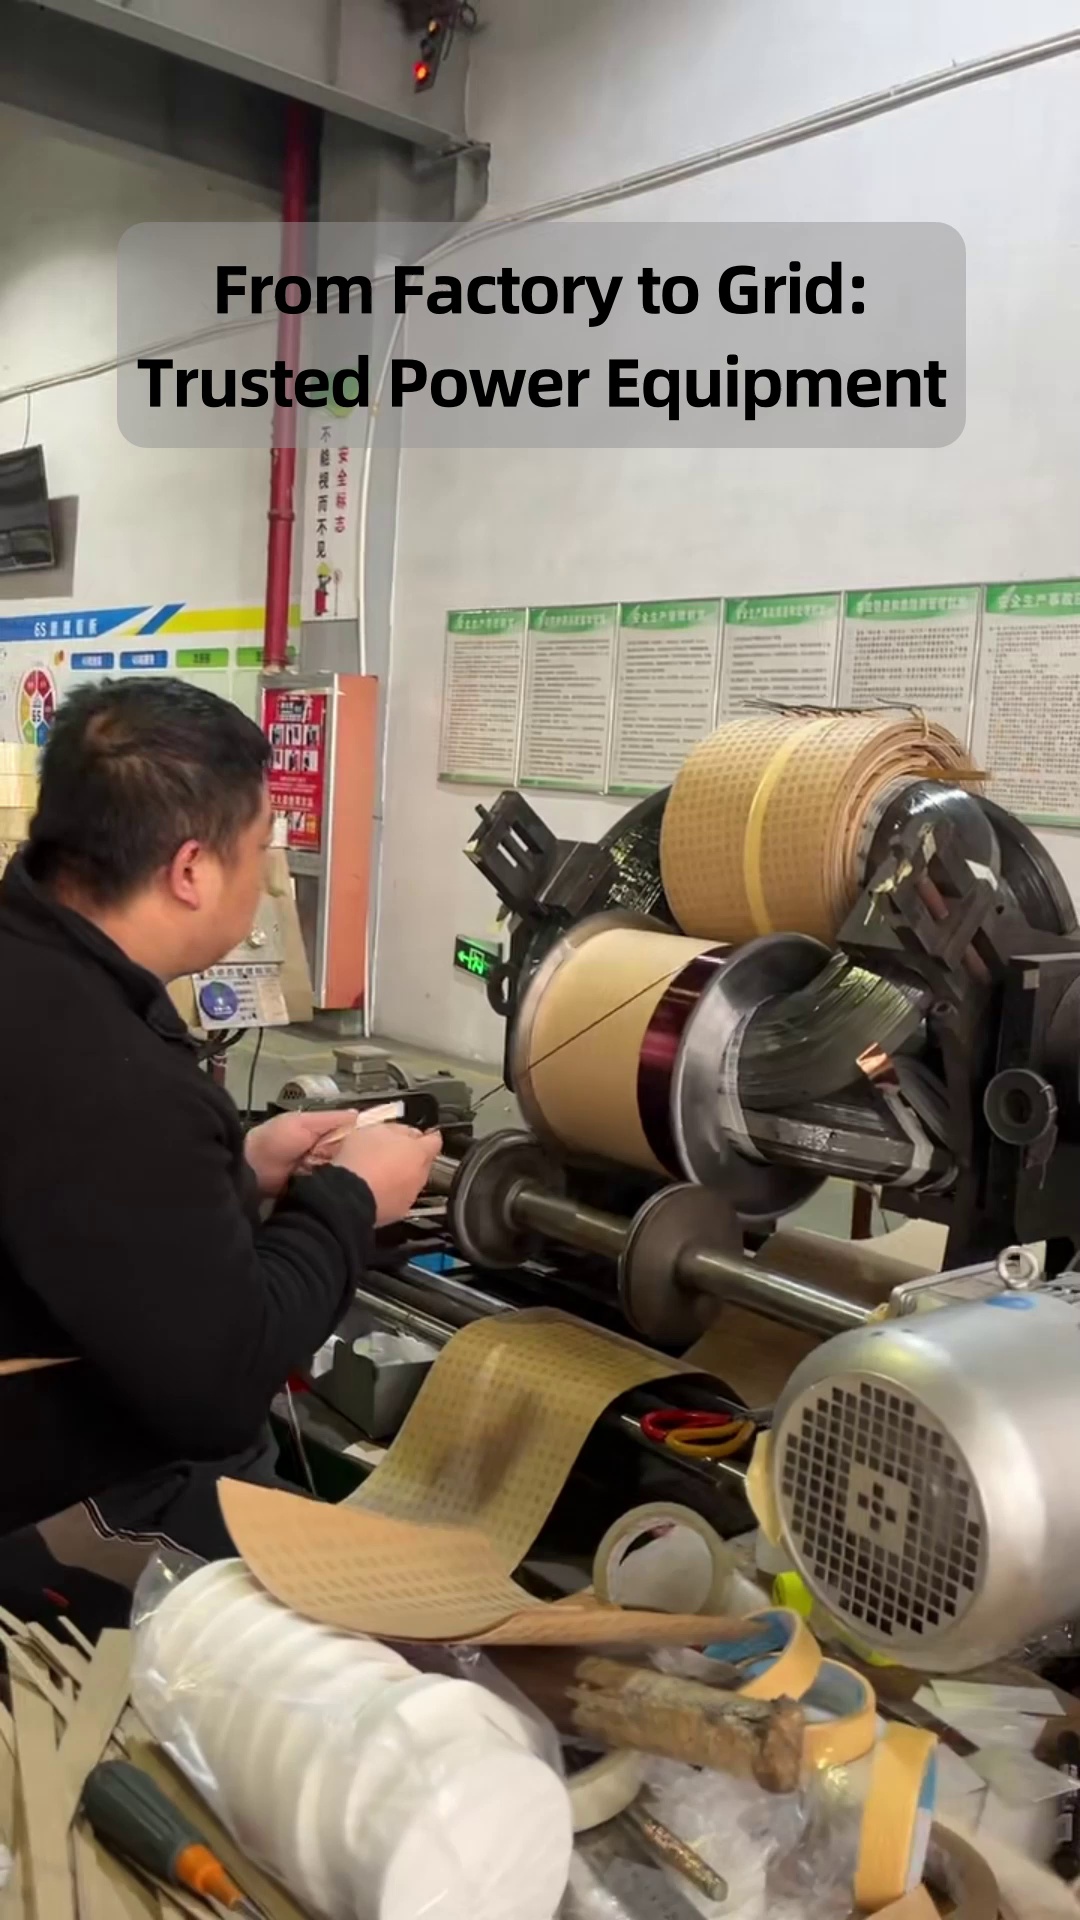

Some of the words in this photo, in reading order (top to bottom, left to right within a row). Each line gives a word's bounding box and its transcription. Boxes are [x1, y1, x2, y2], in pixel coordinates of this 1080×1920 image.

[315, 425, 331, 559] 不能视而不见
